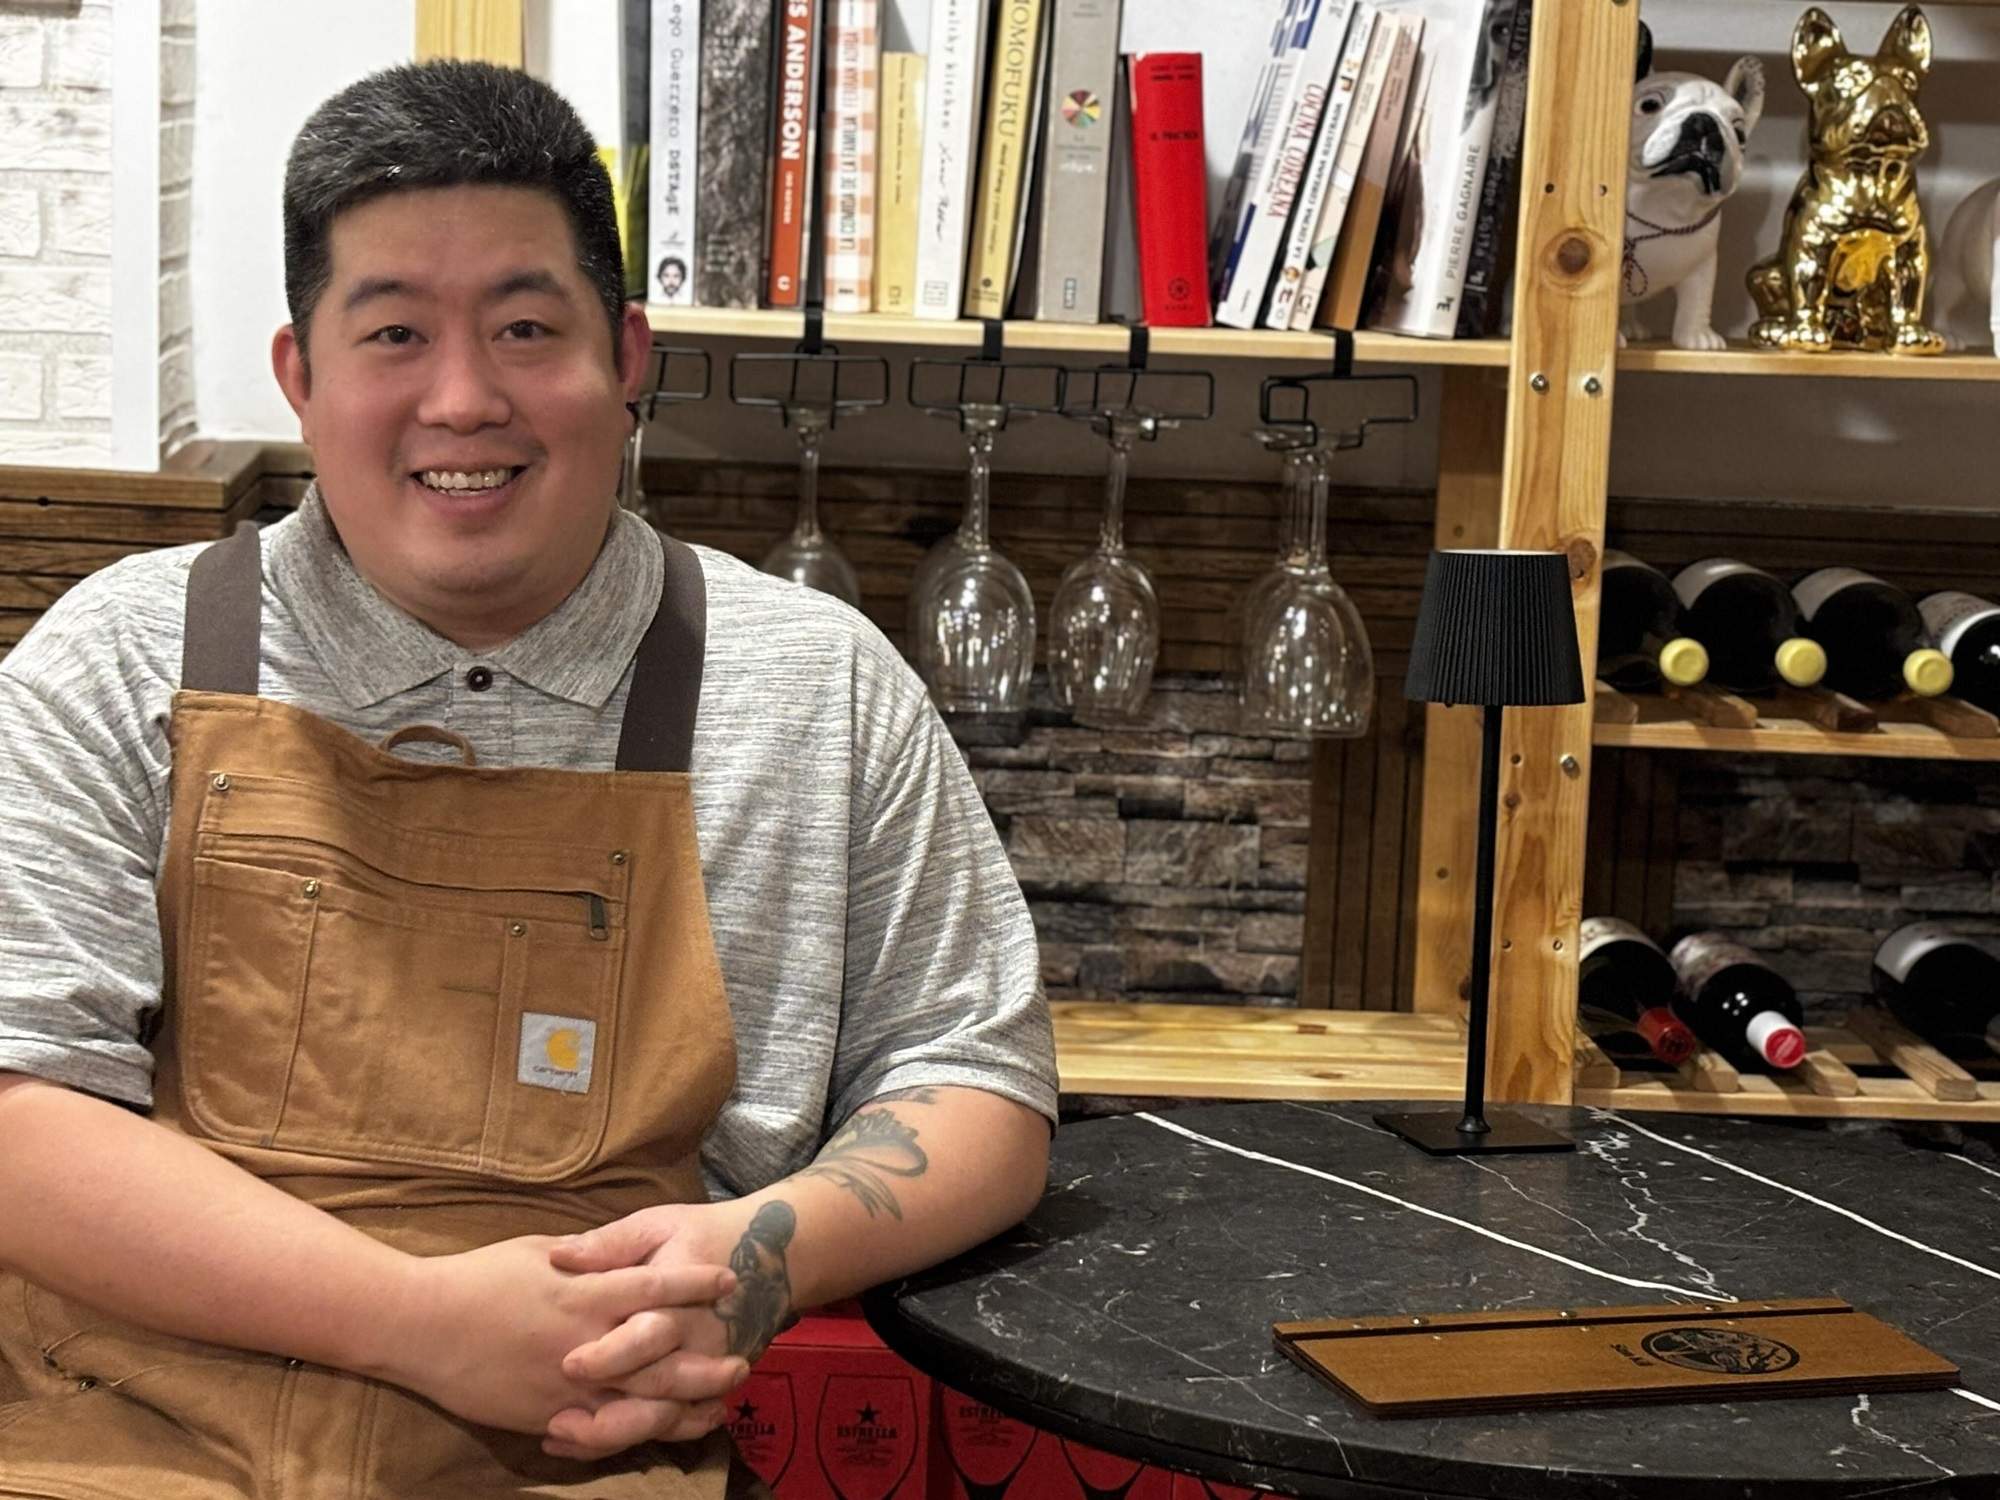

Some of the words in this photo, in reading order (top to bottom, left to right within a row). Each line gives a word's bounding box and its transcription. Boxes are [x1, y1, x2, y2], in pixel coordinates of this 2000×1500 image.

[669, 0, 682, 37] ego
[669, 48, 684, 138] Guerrero
[781, 24, 807, 160] ANDERSON
[941, 62, 959, 130] kitchen
[1298, 83, 1325, 146] COCINA
[841, 115, 857, 158] FAMILIA
[841, 161, 856, 173] LA
[841, 176, 856, 190] DE
[1266, 144, 1308, 219] COREANA
[1309, 156, 1328, 203] COREANA
[840, 193, 856, 234] COMIDA
[1446, 225, 1467, 280] PIERRE
[1457, 143, 1481, 221] GAGNAIRE
[839, 237, 856, 251] LA
